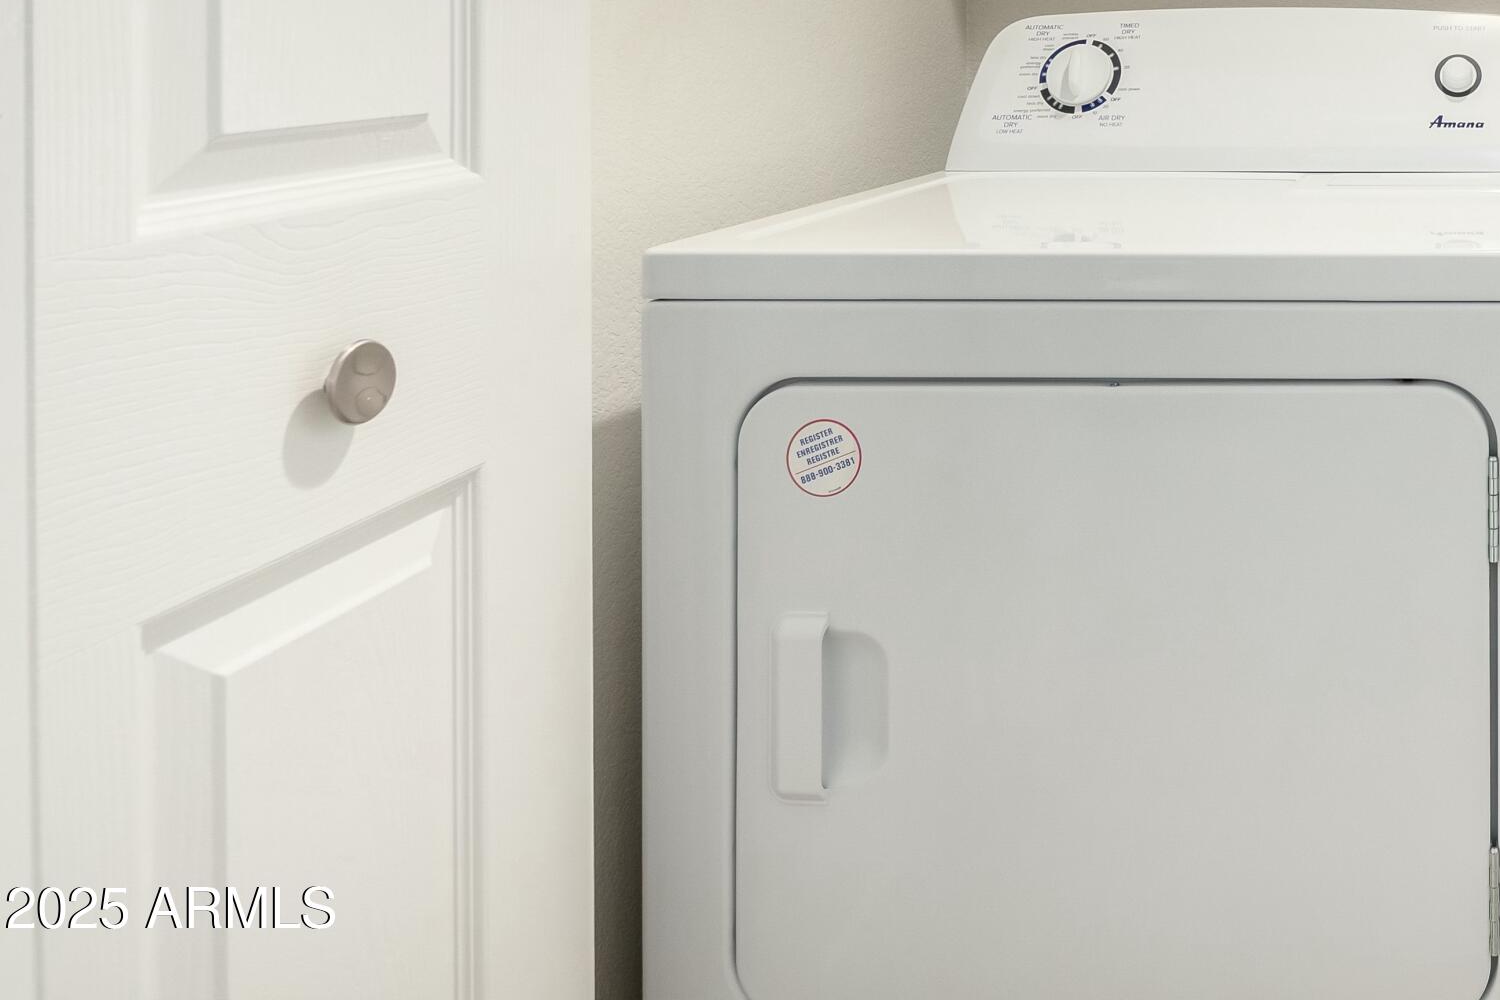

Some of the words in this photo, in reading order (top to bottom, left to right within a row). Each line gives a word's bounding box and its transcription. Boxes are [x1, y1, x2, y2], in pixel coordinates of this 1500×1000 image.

[1429, 115, 1485, 128] Amana
[796, 434, 844, 458] ENREGISTRER
[800, 427, 833, 447] REGISTER
[806, 447, 841, 465] REGISTRE
[800, 456, 855, 484] 888-900-3381
